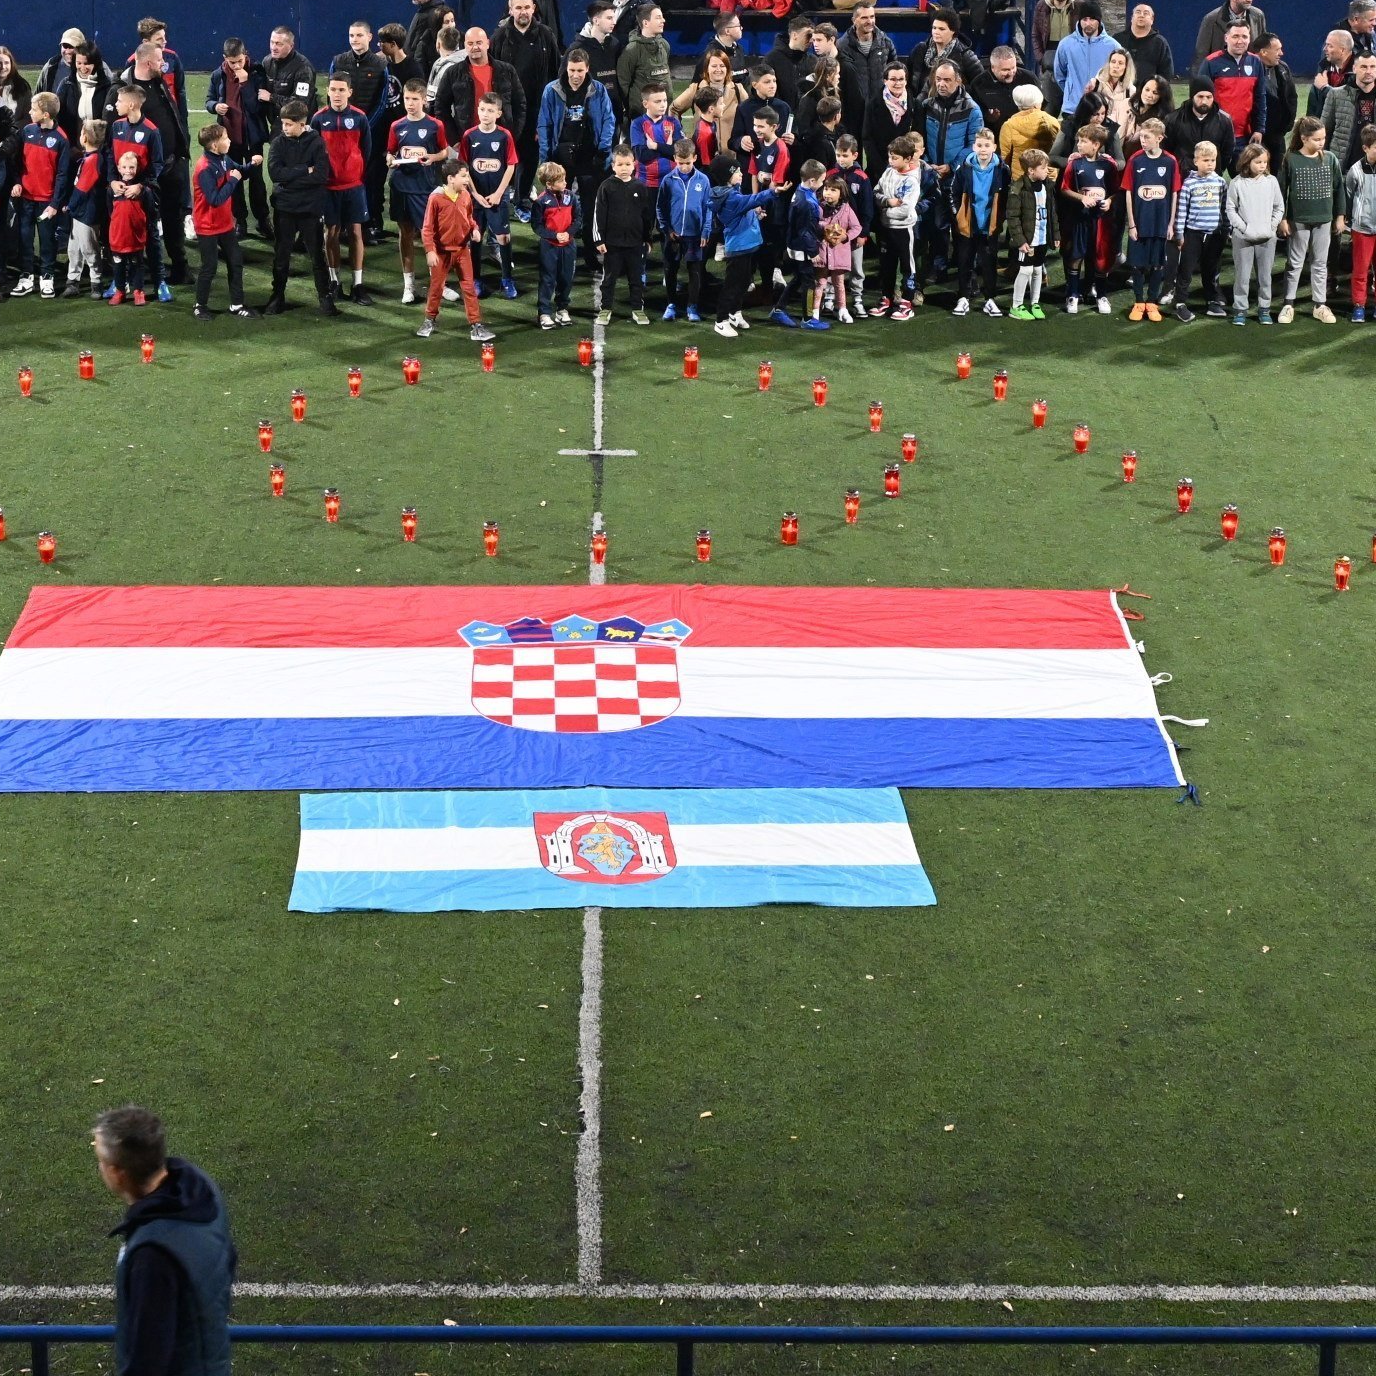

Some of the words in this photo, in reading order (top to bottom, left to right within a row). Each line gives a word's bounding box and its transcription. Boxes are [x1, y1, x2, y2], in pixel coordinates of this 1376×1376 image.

[403, 147, 425, 160] Tarsa
[477, 159, 498, 172] Tarsa
[1142, 187, 1164, 199] Tarsa
